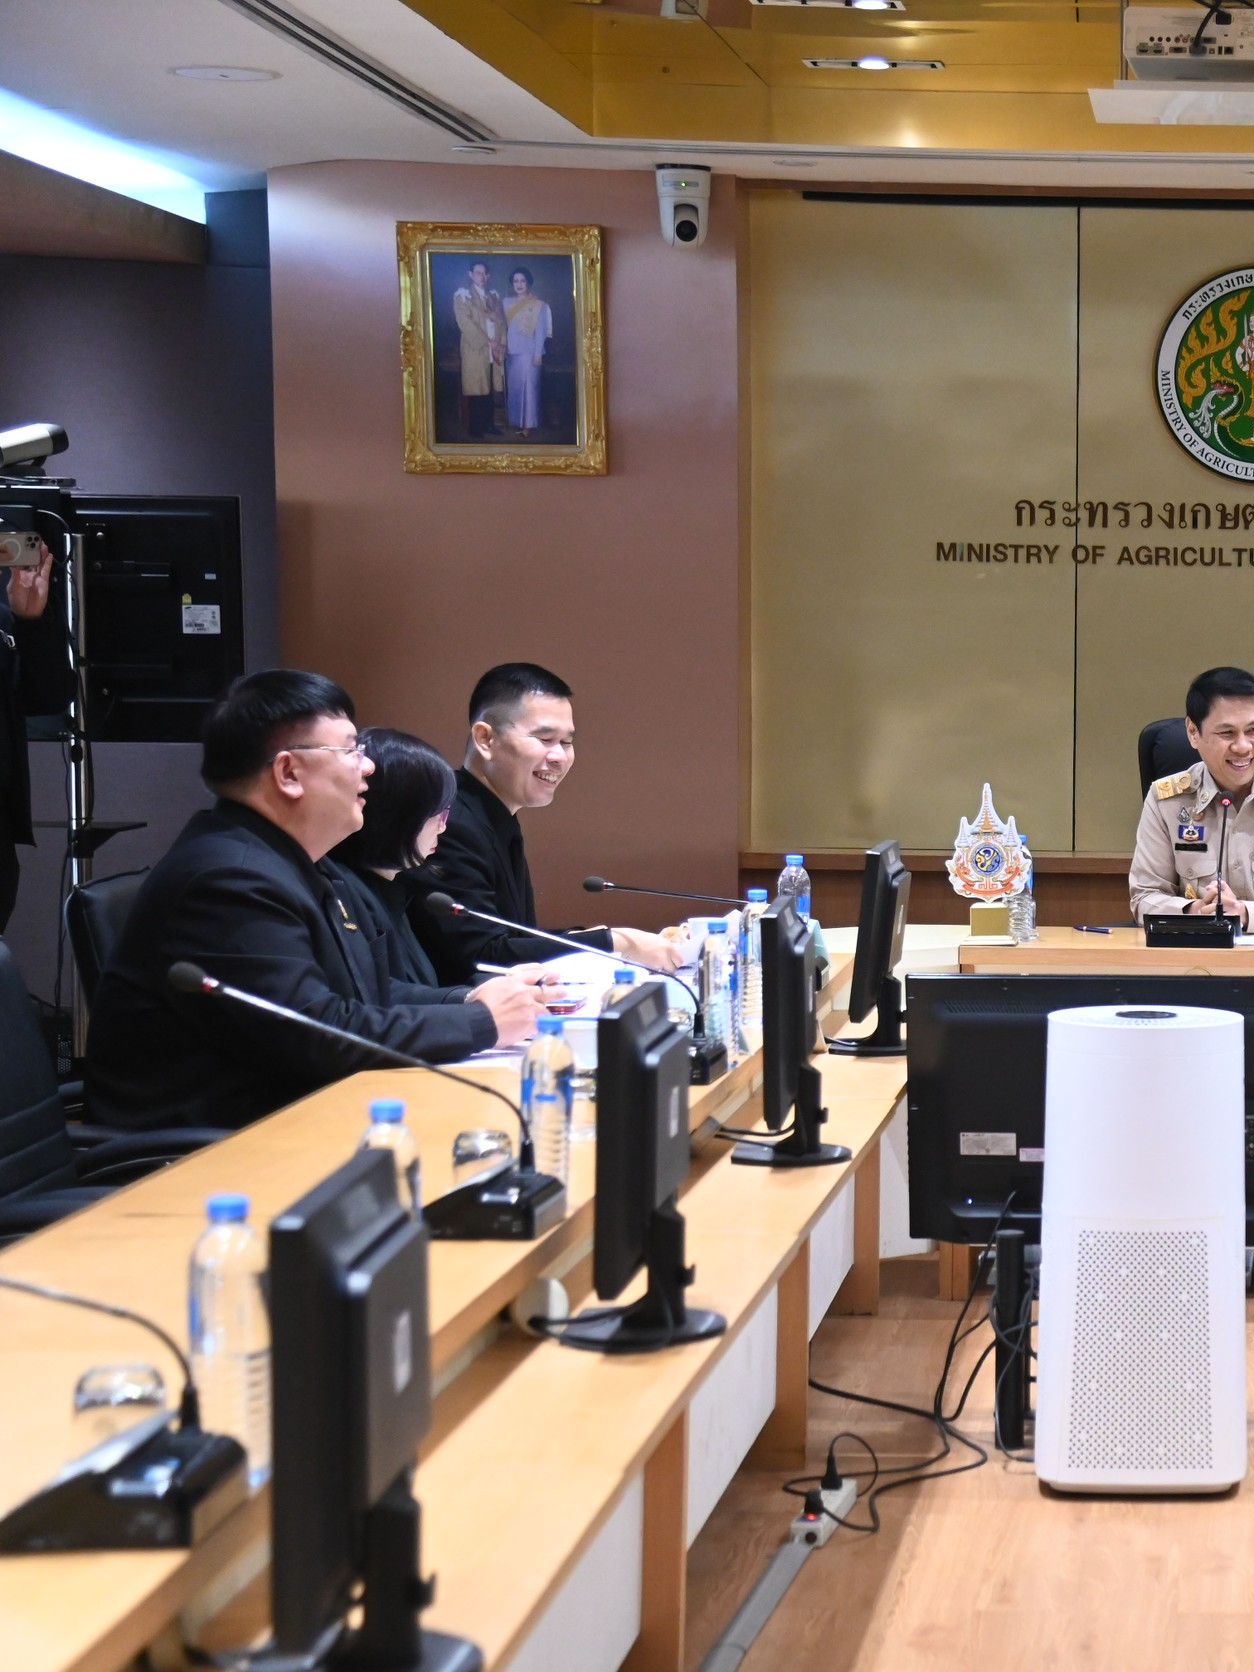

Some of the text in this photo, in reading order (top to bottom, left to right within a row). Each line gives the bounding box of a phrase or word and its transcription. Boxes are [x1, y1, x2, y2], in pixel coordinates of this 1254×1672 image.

[1160, 369, 1187, 432] MINISTRY
[1182, 432, 1199, 449] OF
[935, 541, 1060, 564] MINISTRY
[1071, 543, 1106, 566] OF
